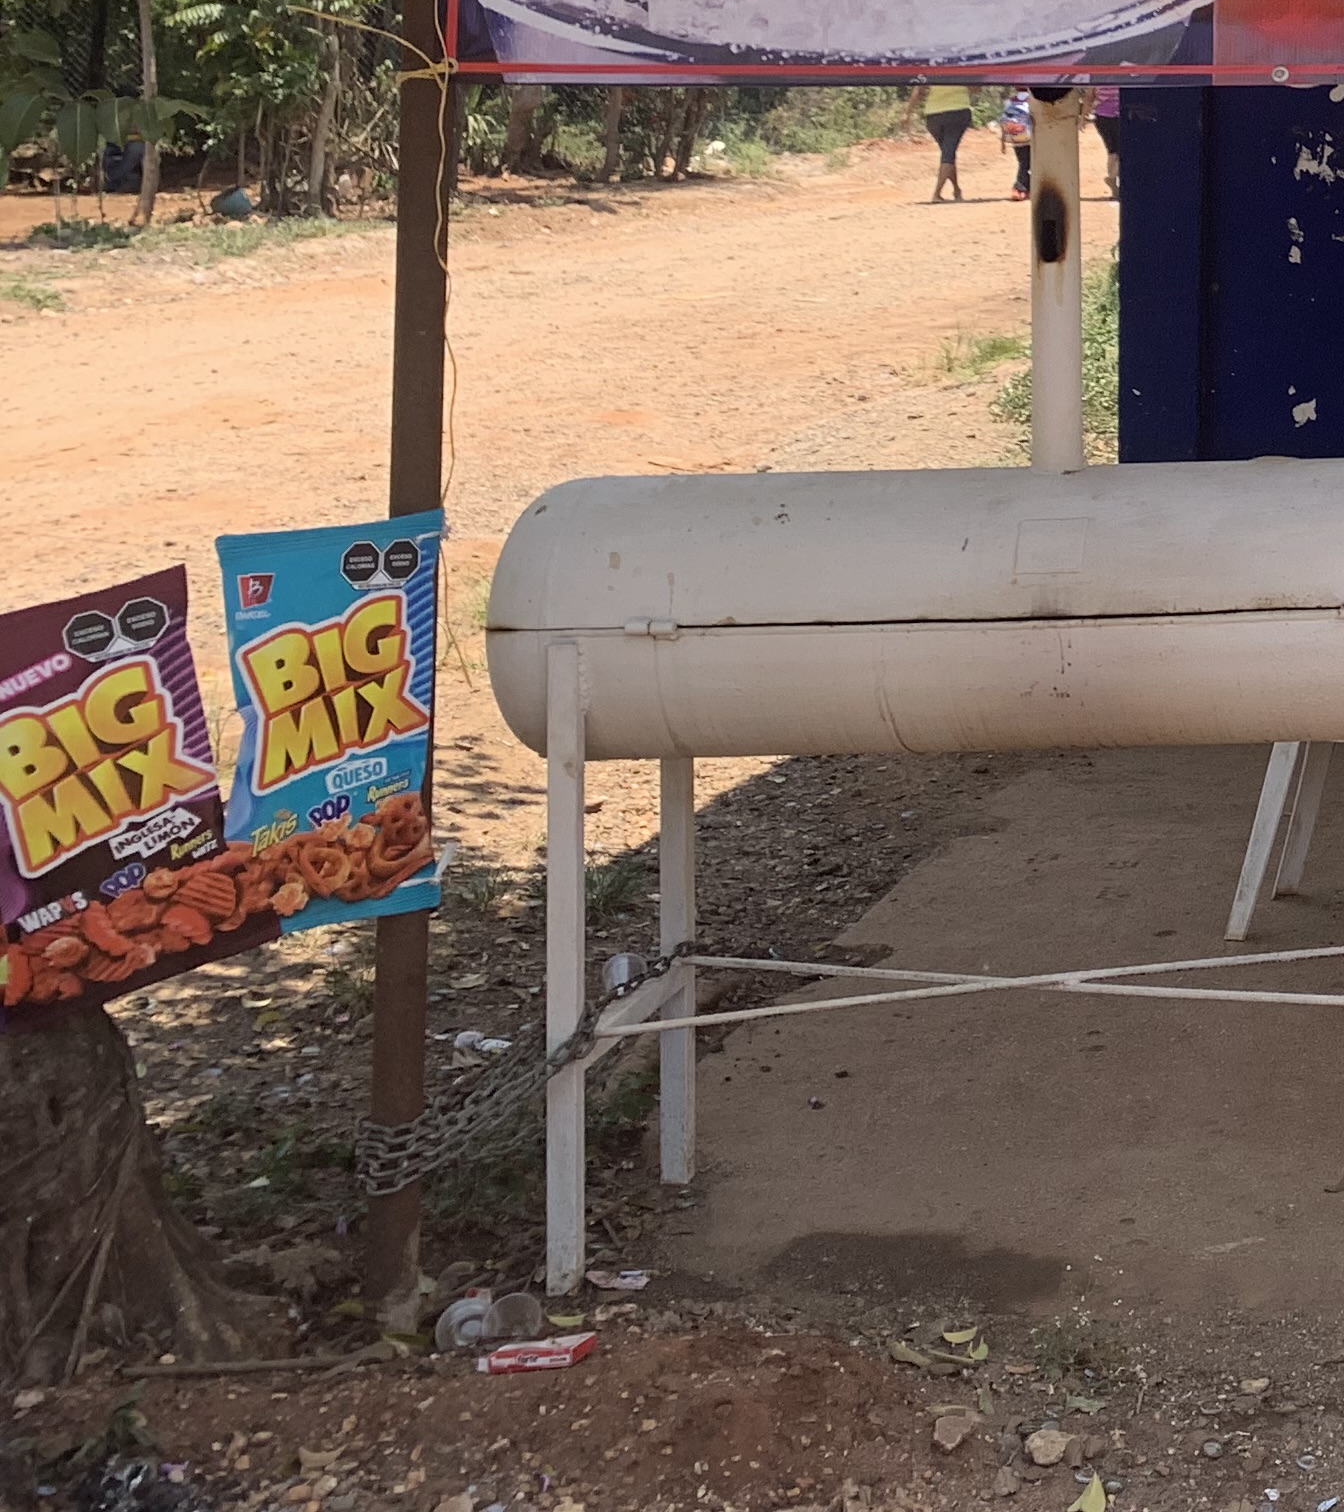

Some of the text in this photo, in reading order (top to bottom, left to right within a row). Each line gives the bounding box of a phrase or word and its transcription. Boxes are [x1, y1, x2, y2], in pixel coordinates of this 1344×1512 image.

[0, 654, 71, 700] NUEVO
[245, 597, 403, 715] BIG
[0, 664, 162, 802] BIG
[261, 663, 425, 787] MIX
[332, 761, 384, 790] QUESO
[16, 727, 210, 869] MIX
[308, 793, 351, 828] POP
